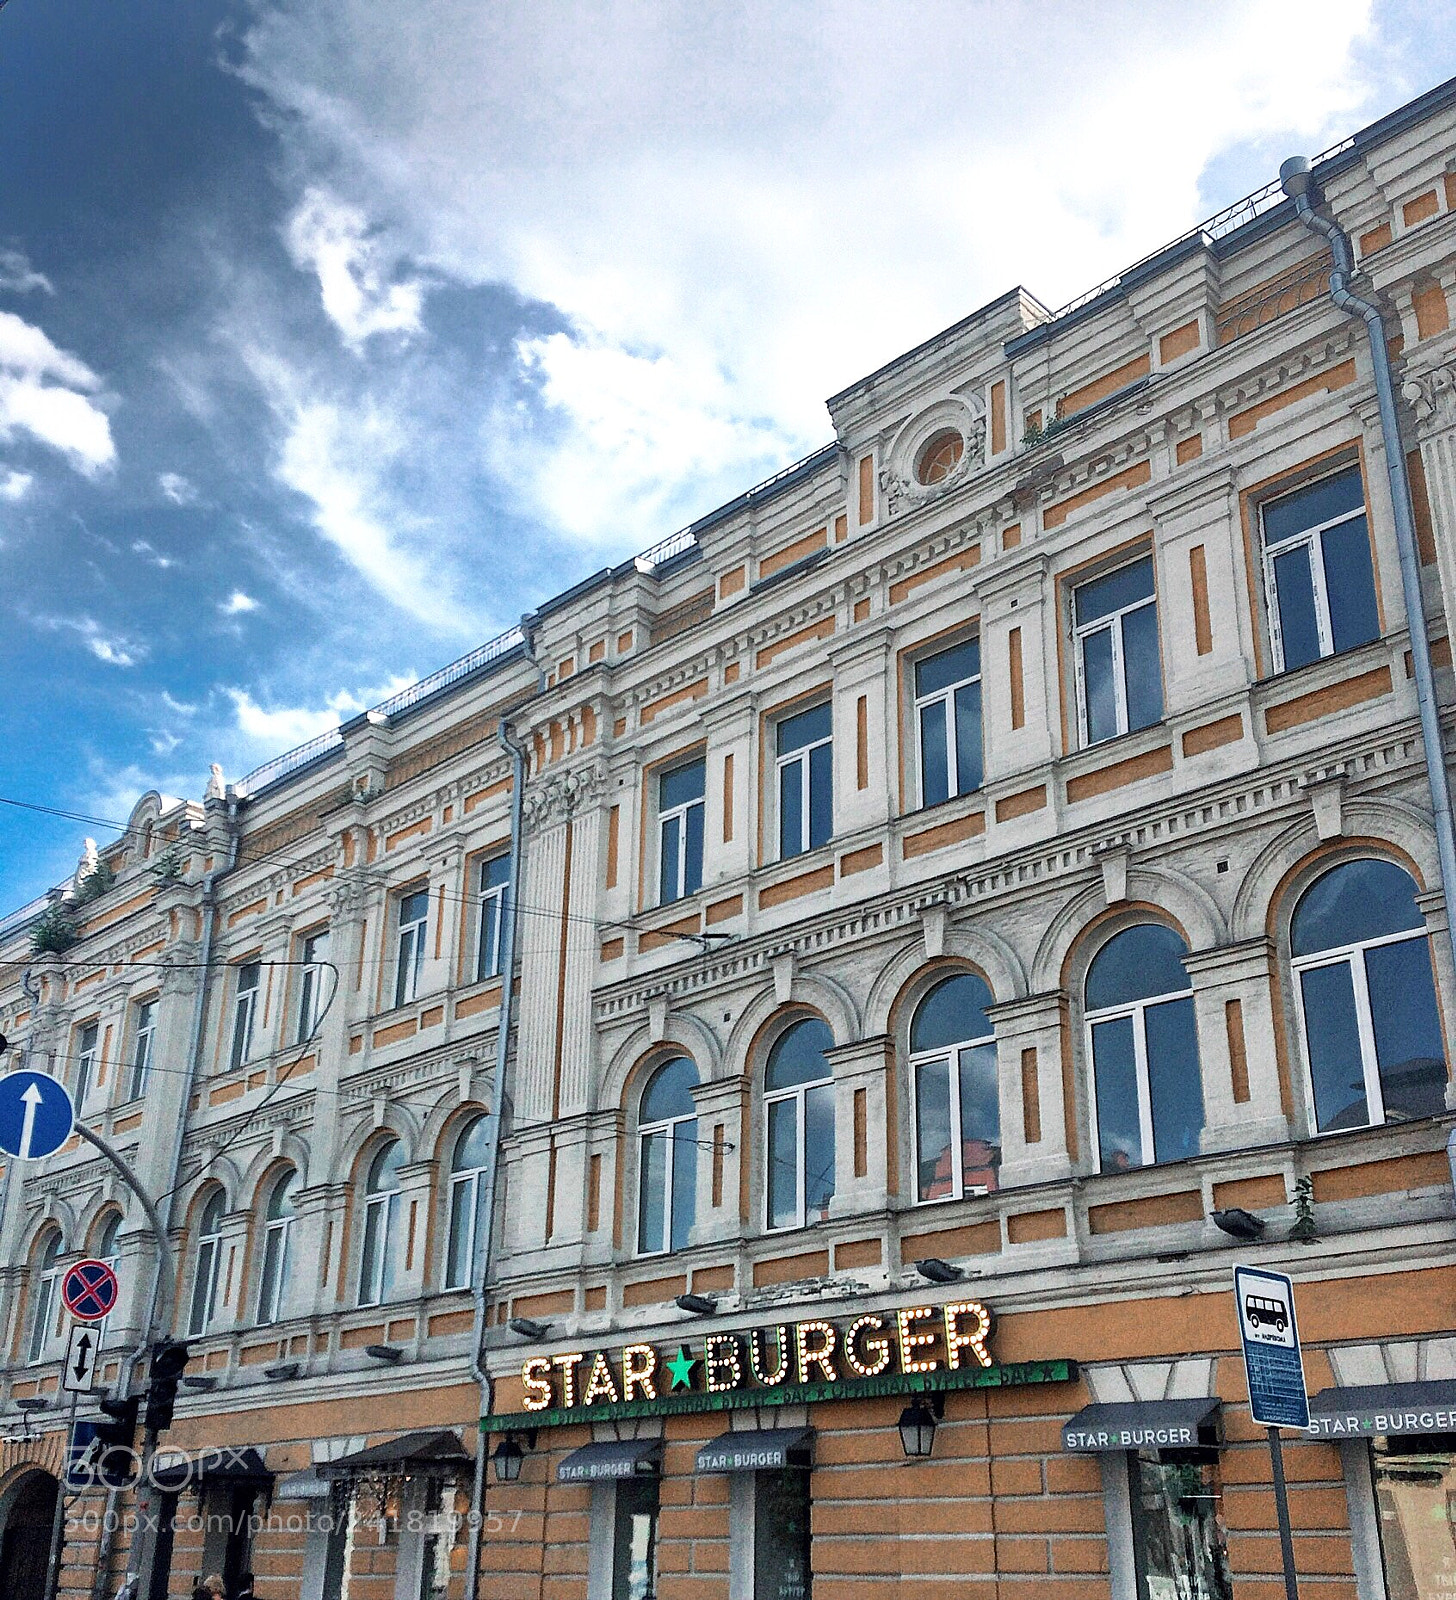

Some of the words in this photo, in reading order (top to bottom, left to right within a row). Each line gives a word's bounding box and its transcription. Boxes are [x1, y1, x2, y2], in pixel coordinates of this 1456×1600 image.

[522, 1343, 657, 1412] STAR
[705, 1301, 993, 1394] BURGER
[1309, 1417, 1360, 1434] STAR
[1066, 1432, 1109, 1448] STAR
[1121, 1428, 1191, 1445] BURGER
[698, 1455, 727, 1469] STAR
[734, 1451, 782, 1467] BURGER
[559, 1464, 585, 1480] STAR
[590, 1461, 631, 1478] BURGER
